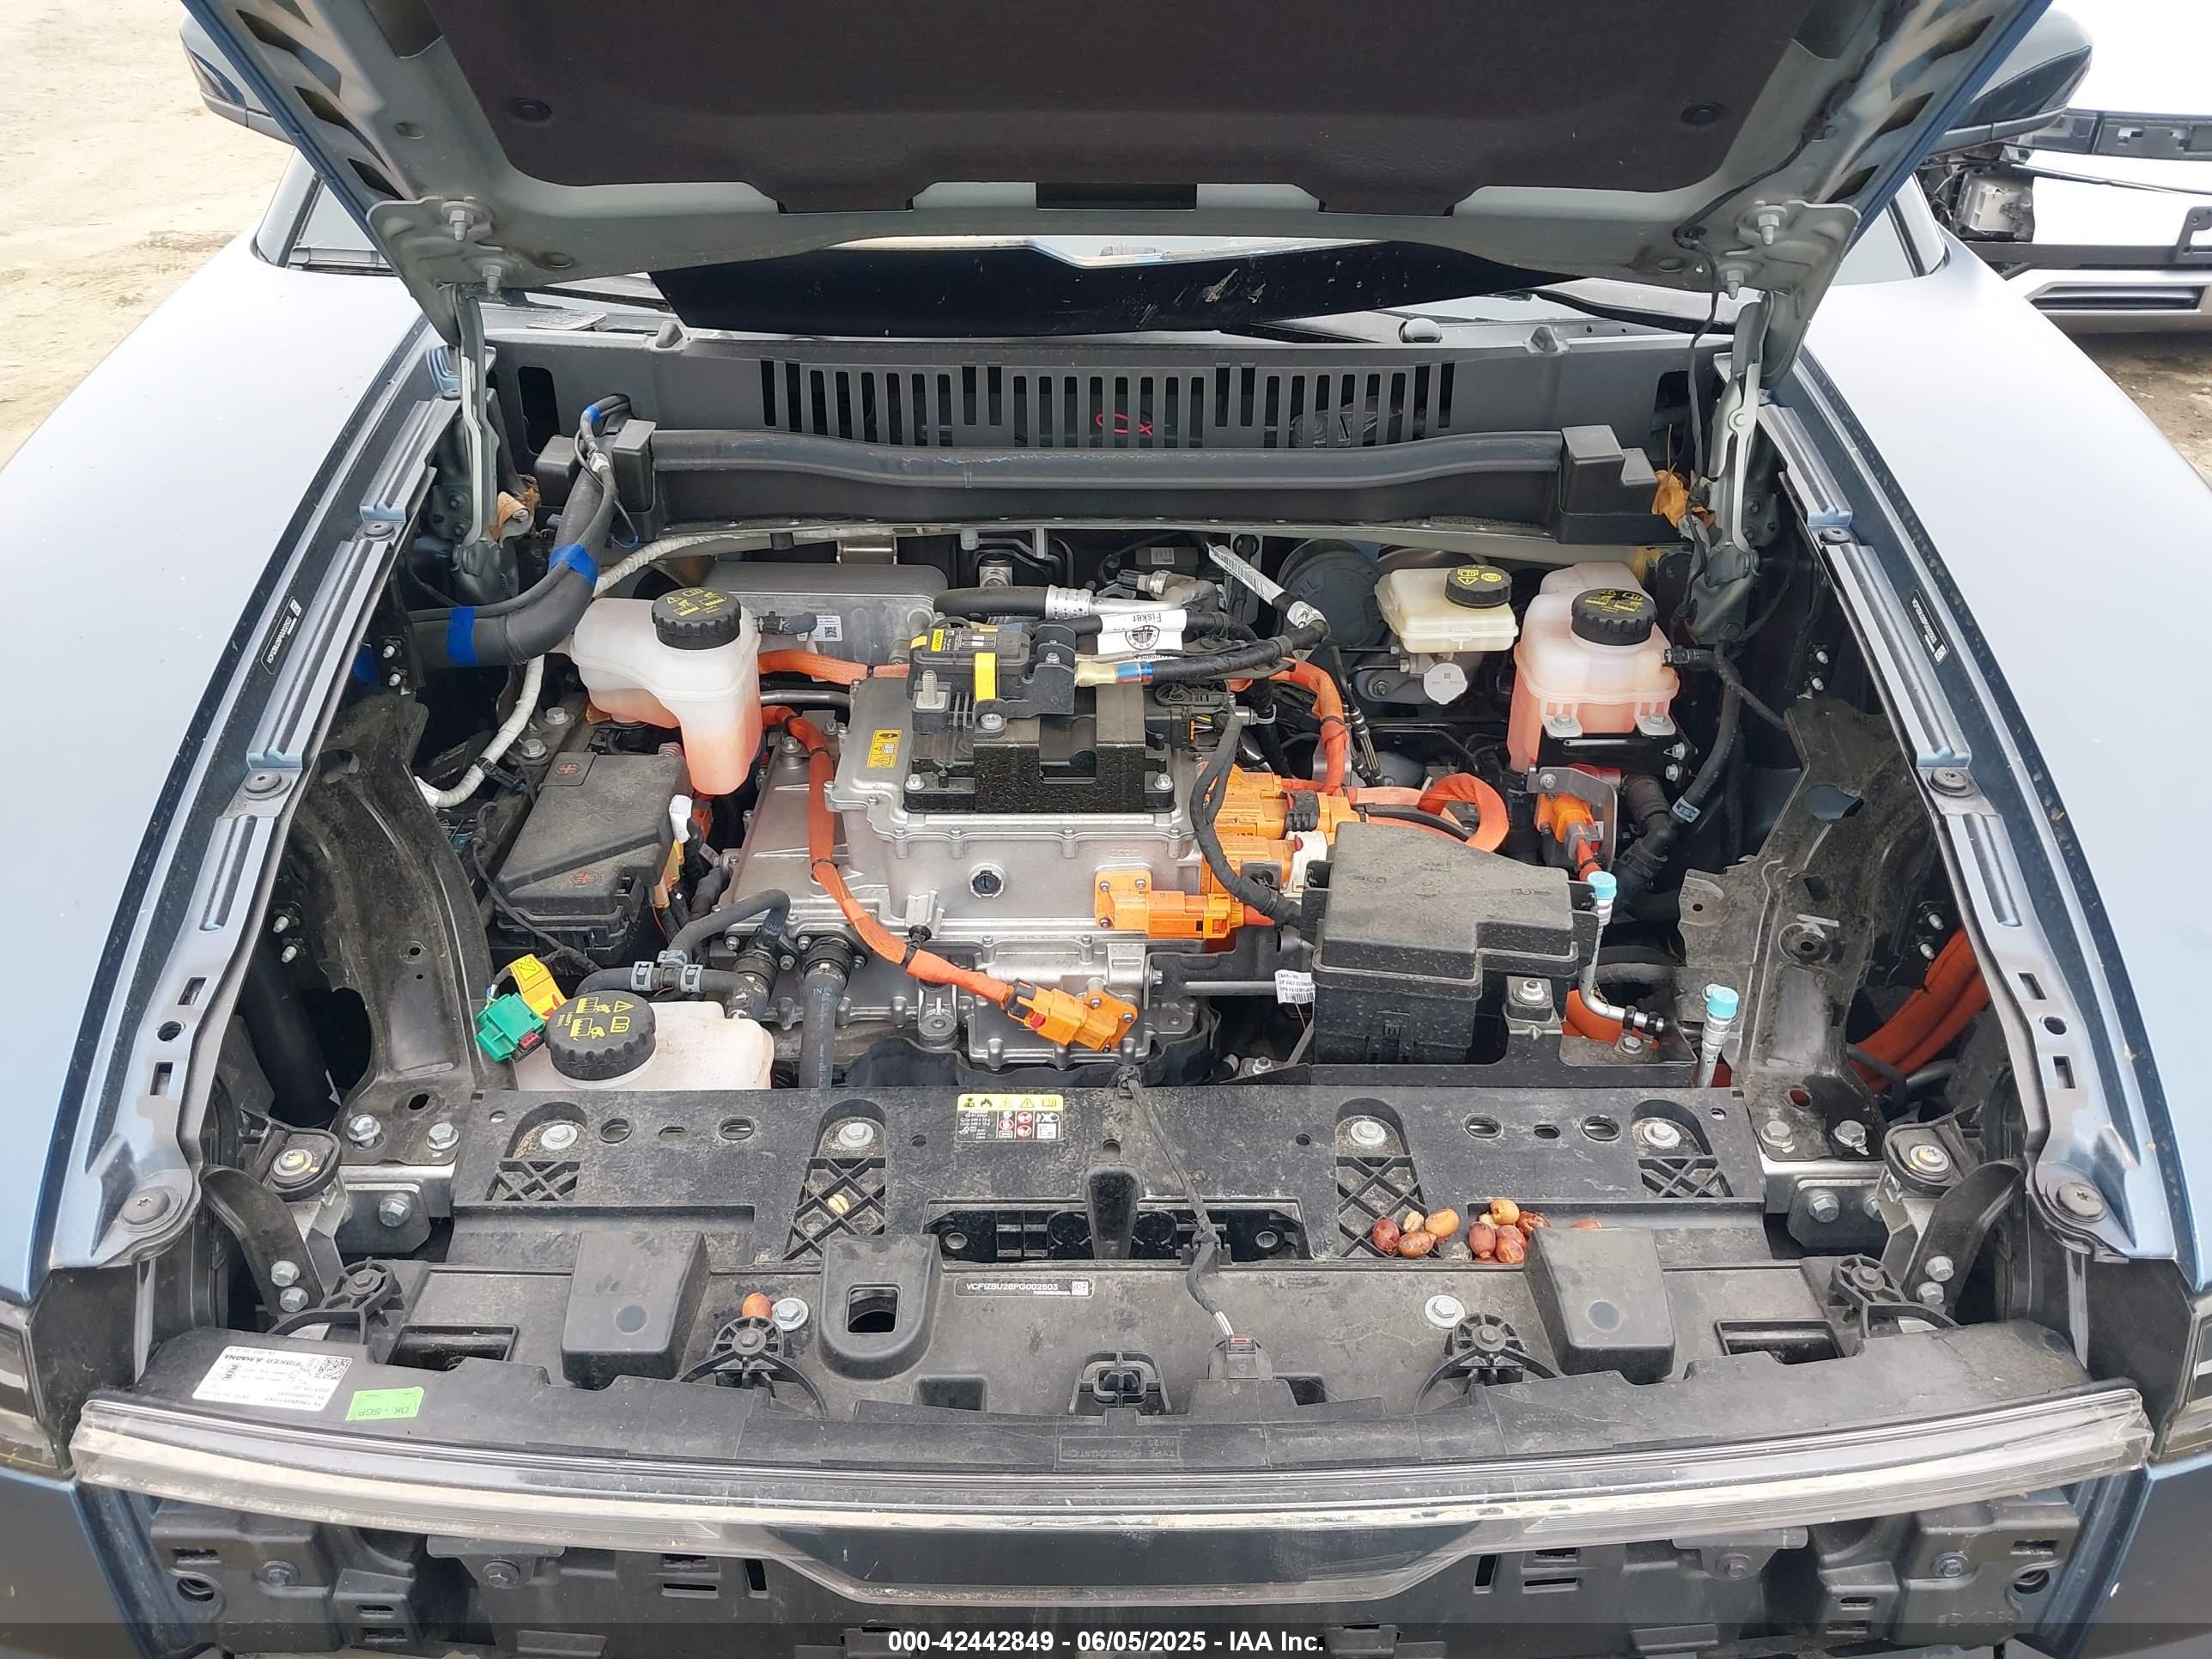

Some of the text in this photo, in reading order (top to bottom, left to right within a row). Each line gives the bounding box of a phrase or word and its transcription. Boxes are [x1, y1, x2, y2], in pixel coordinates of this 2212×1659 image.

[1132, 612, 1163, 624] Fisker
[357, 1407, 382, 1418] SGP
[1062, 1449, 1142, 1458] HOMOLOGATION
